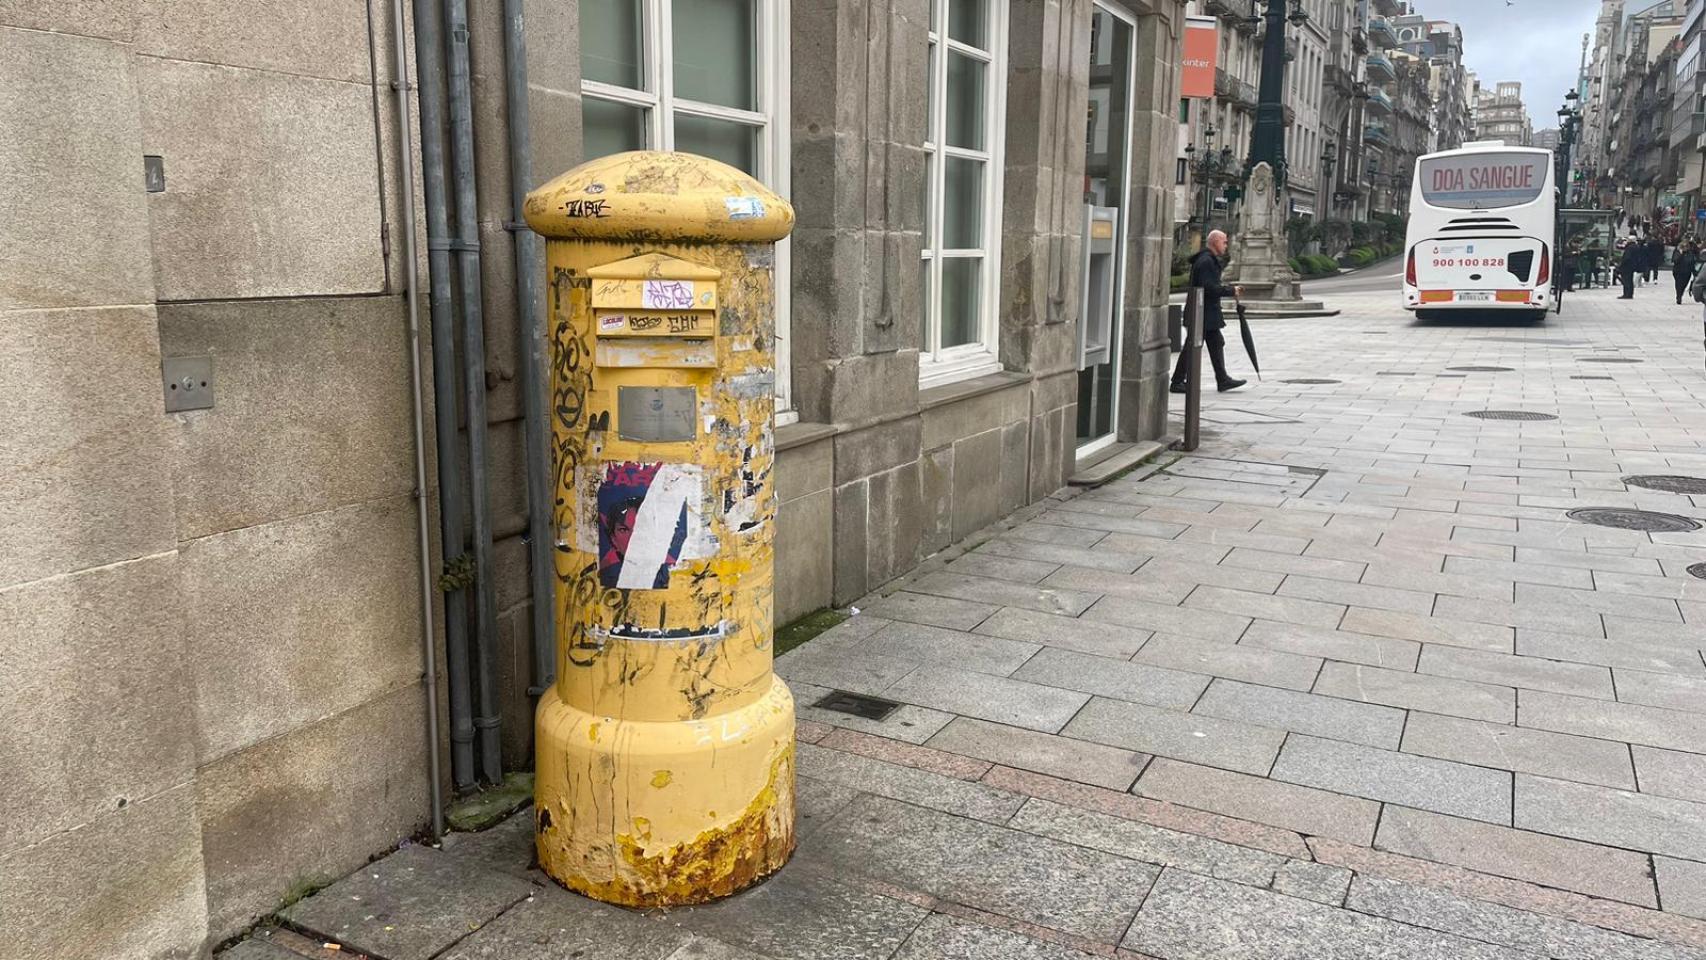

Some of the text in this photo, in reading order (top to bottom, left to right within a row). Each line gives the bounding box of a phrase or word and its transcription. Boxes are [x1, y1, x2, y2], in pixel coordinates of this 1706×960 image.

[1432, 164, 1534, 191] DOA SANGUE
[1433, 258, 1504, 267] 900 100 828
